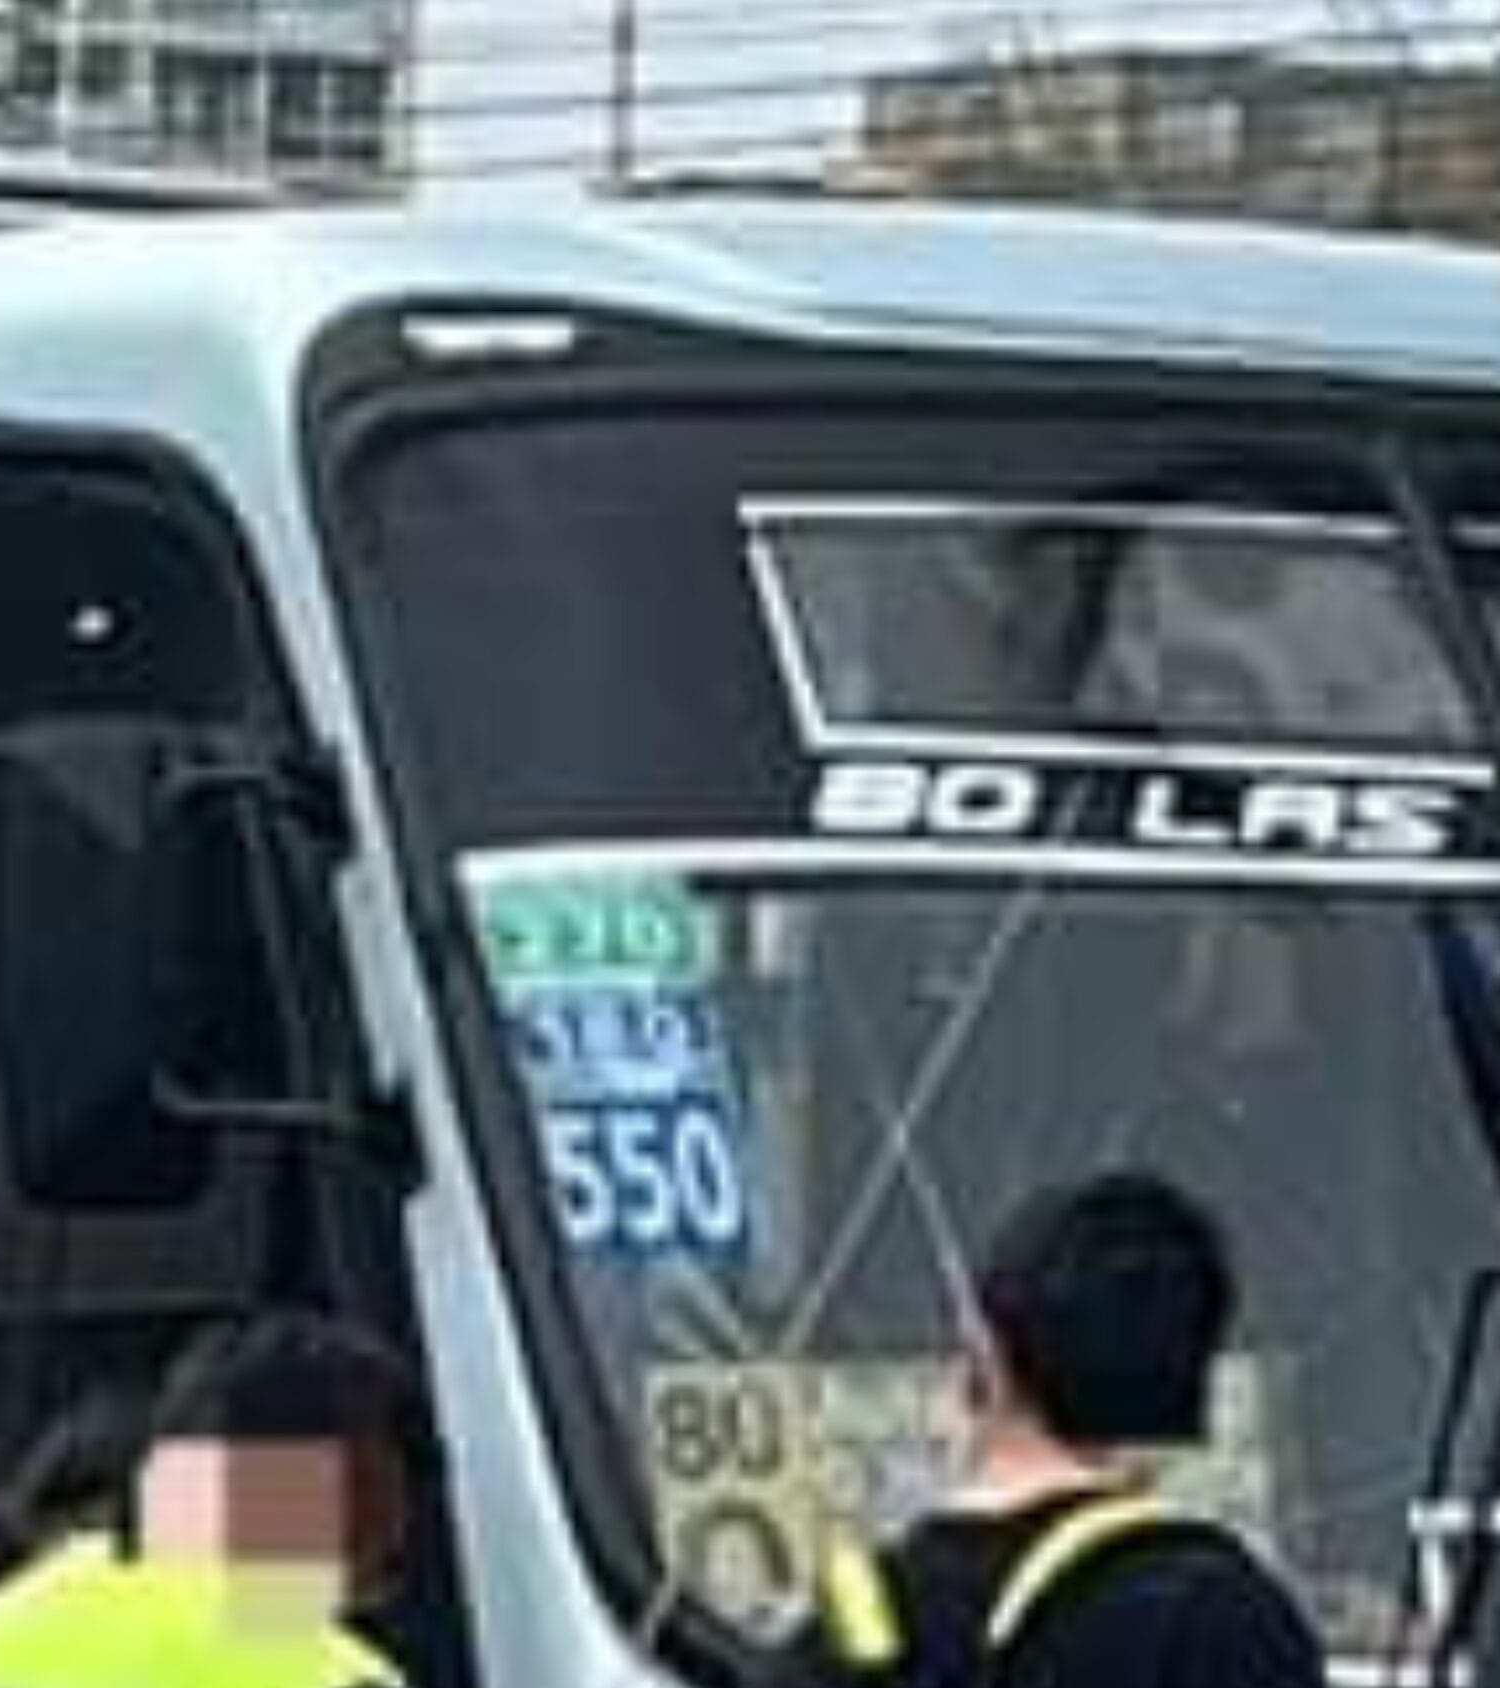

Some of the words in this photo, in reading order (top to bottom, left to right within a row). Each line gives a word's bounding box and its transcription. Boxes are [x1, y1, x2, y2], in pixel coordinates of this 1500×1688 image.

[1132, 772, 1462, 856] LAS
[540, 1108, 744, 1244] 550
[656, 1376, 782, 1480] 80
